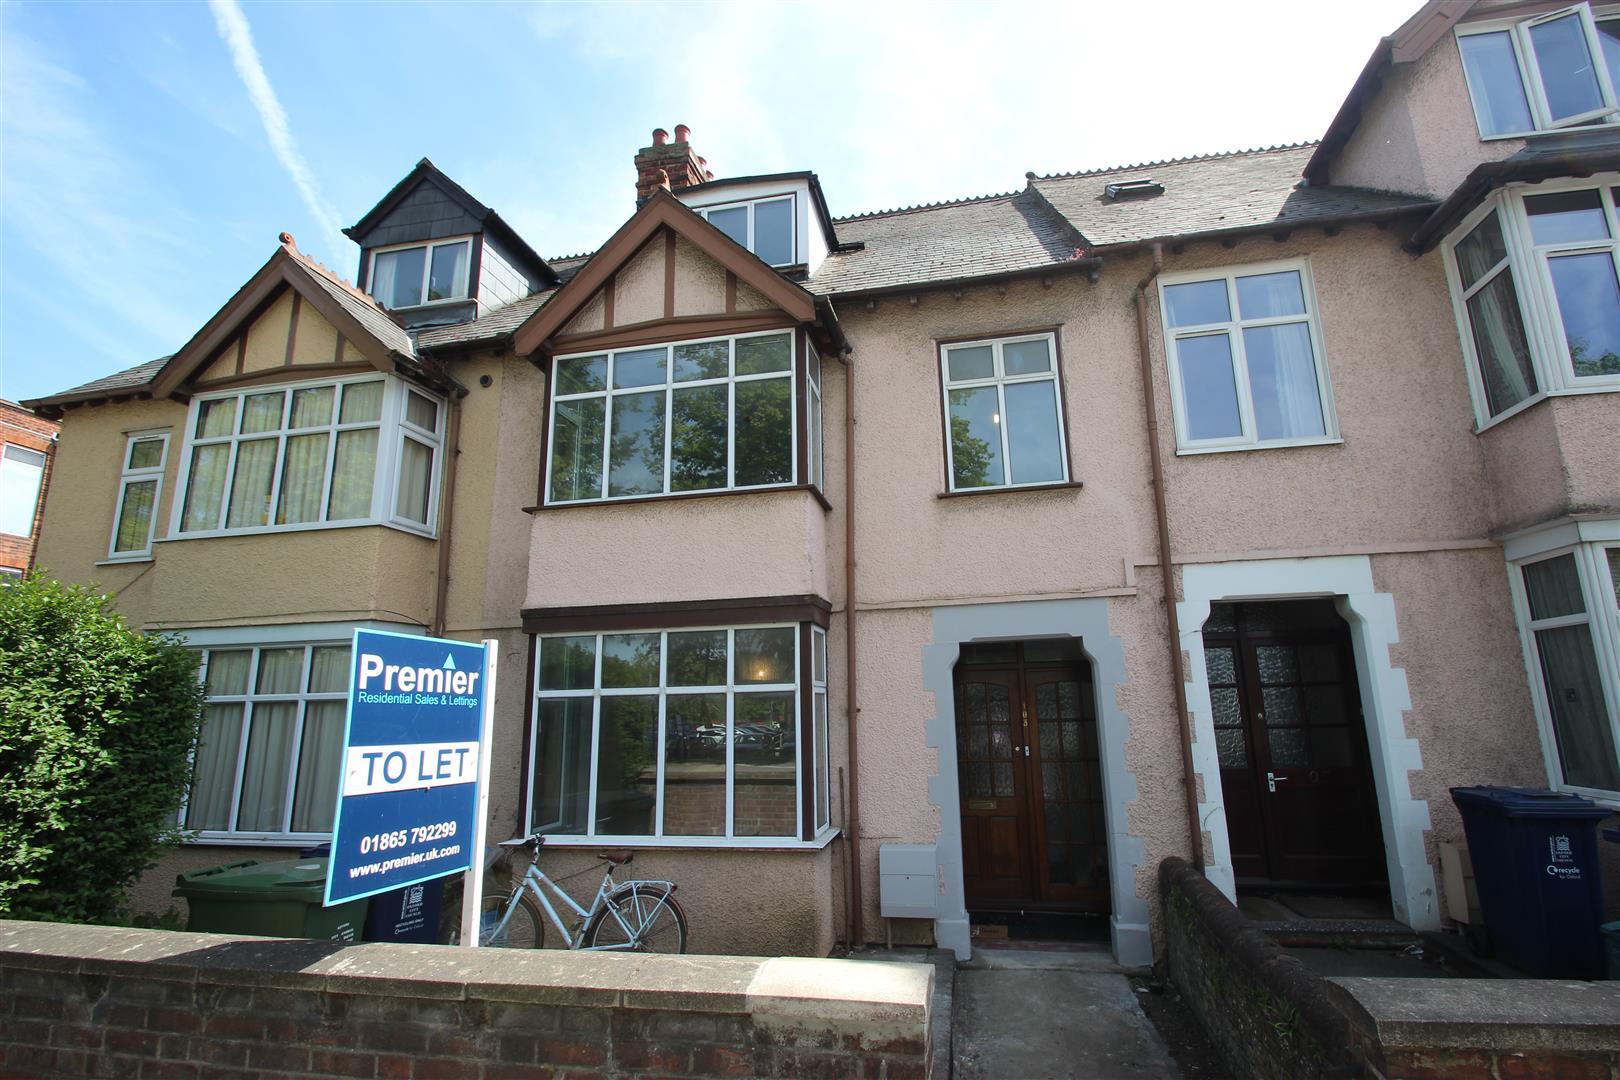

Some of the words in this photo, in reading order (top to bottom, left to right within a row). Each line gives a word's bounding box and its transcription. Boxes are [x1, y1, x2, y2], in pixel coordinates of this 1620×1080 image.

[359, 653, 479, 694] Premier
[358, 691, 413, 705] Residential
[415, 694, 439, 705] Sales
[441, 695, 447, 705] &
[449, 696, 478, 709] Lettings
[362, 751, 407, 785] TO
[418, 748, 470, 781] LET
[360, 829, 408, 855] 01865
[411, 820, 457, 845] 792299
[349, 844, 461, 879] www.premier.uk.com
[1558, 866, 1580, 874] recycle
